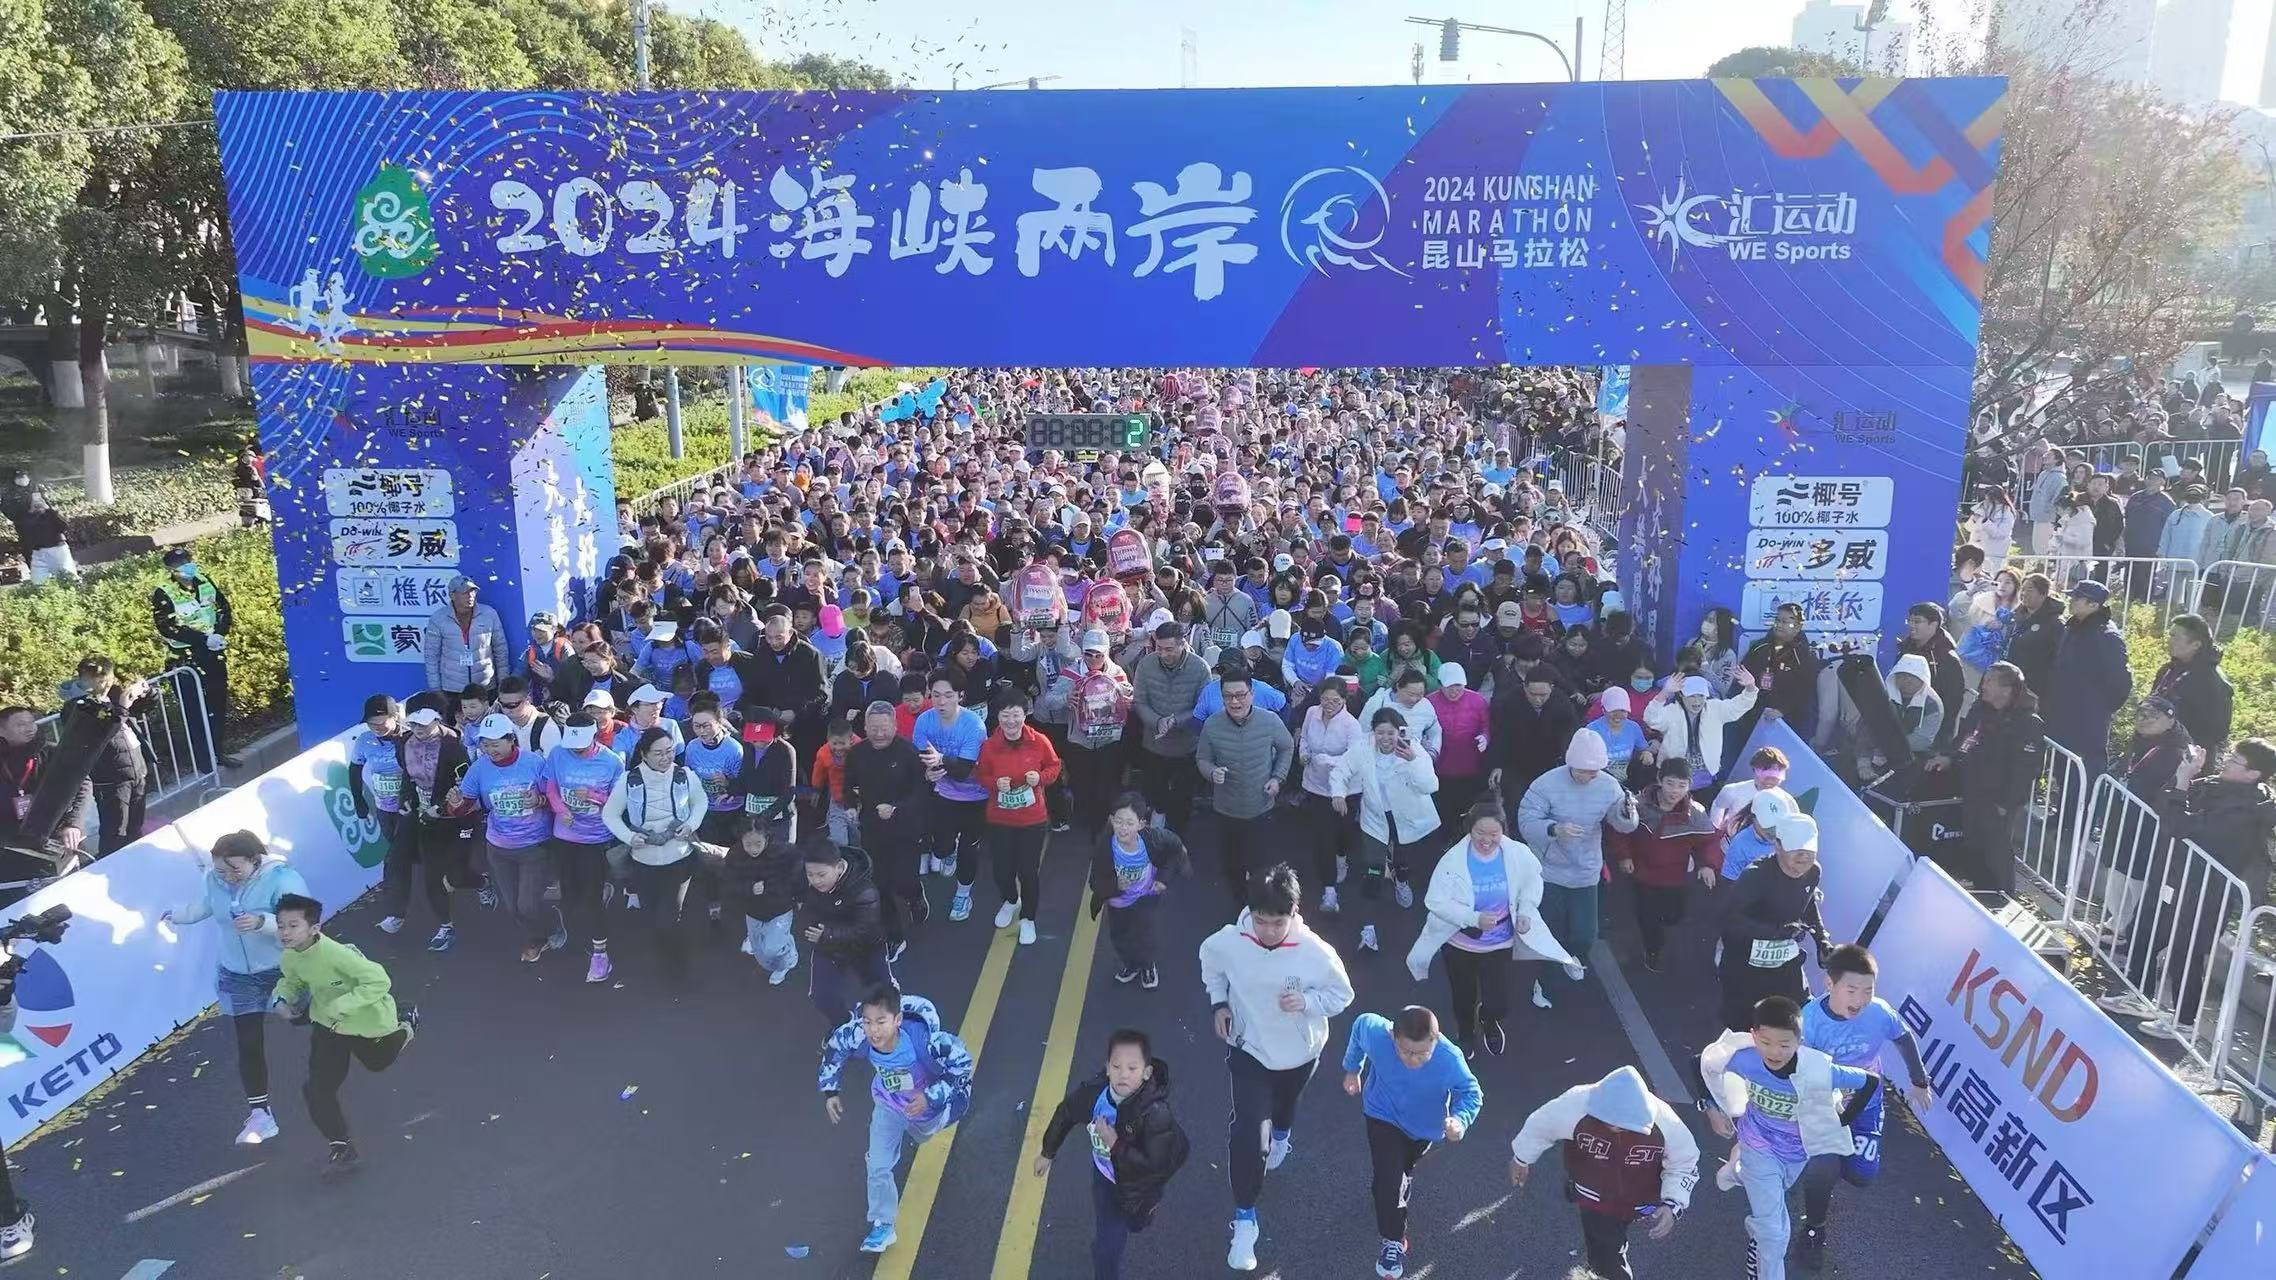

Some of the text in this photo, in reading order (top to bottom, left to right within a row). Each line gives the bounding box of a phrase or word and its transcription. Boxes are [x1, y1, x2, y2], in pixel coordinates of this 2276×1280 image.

[1424, 174, 1594, 202] 2024 KUNSHAN
[1422, 207, 1592, 235] MARATHON
[1728, 191, 1857, 236] 汇运动
[489, 162, 1258, 301] 2024 海峡两岸
[1421, 237, 1590, 270] 昆山马拉松
[1728, 240, 1852, 264] WE Sports
[1834, 432, 1896, 447] WE Sports
[1811, 481, 1863, 507] 椰号
[387, 528, 448, 559] 多威
[1803, 538, 1878, 571] 多威
[390, 624, 426, 655] 蒙
[1945, 947, 2100, 1125] KSND
[7, 1031, 124, 1120] KETD
